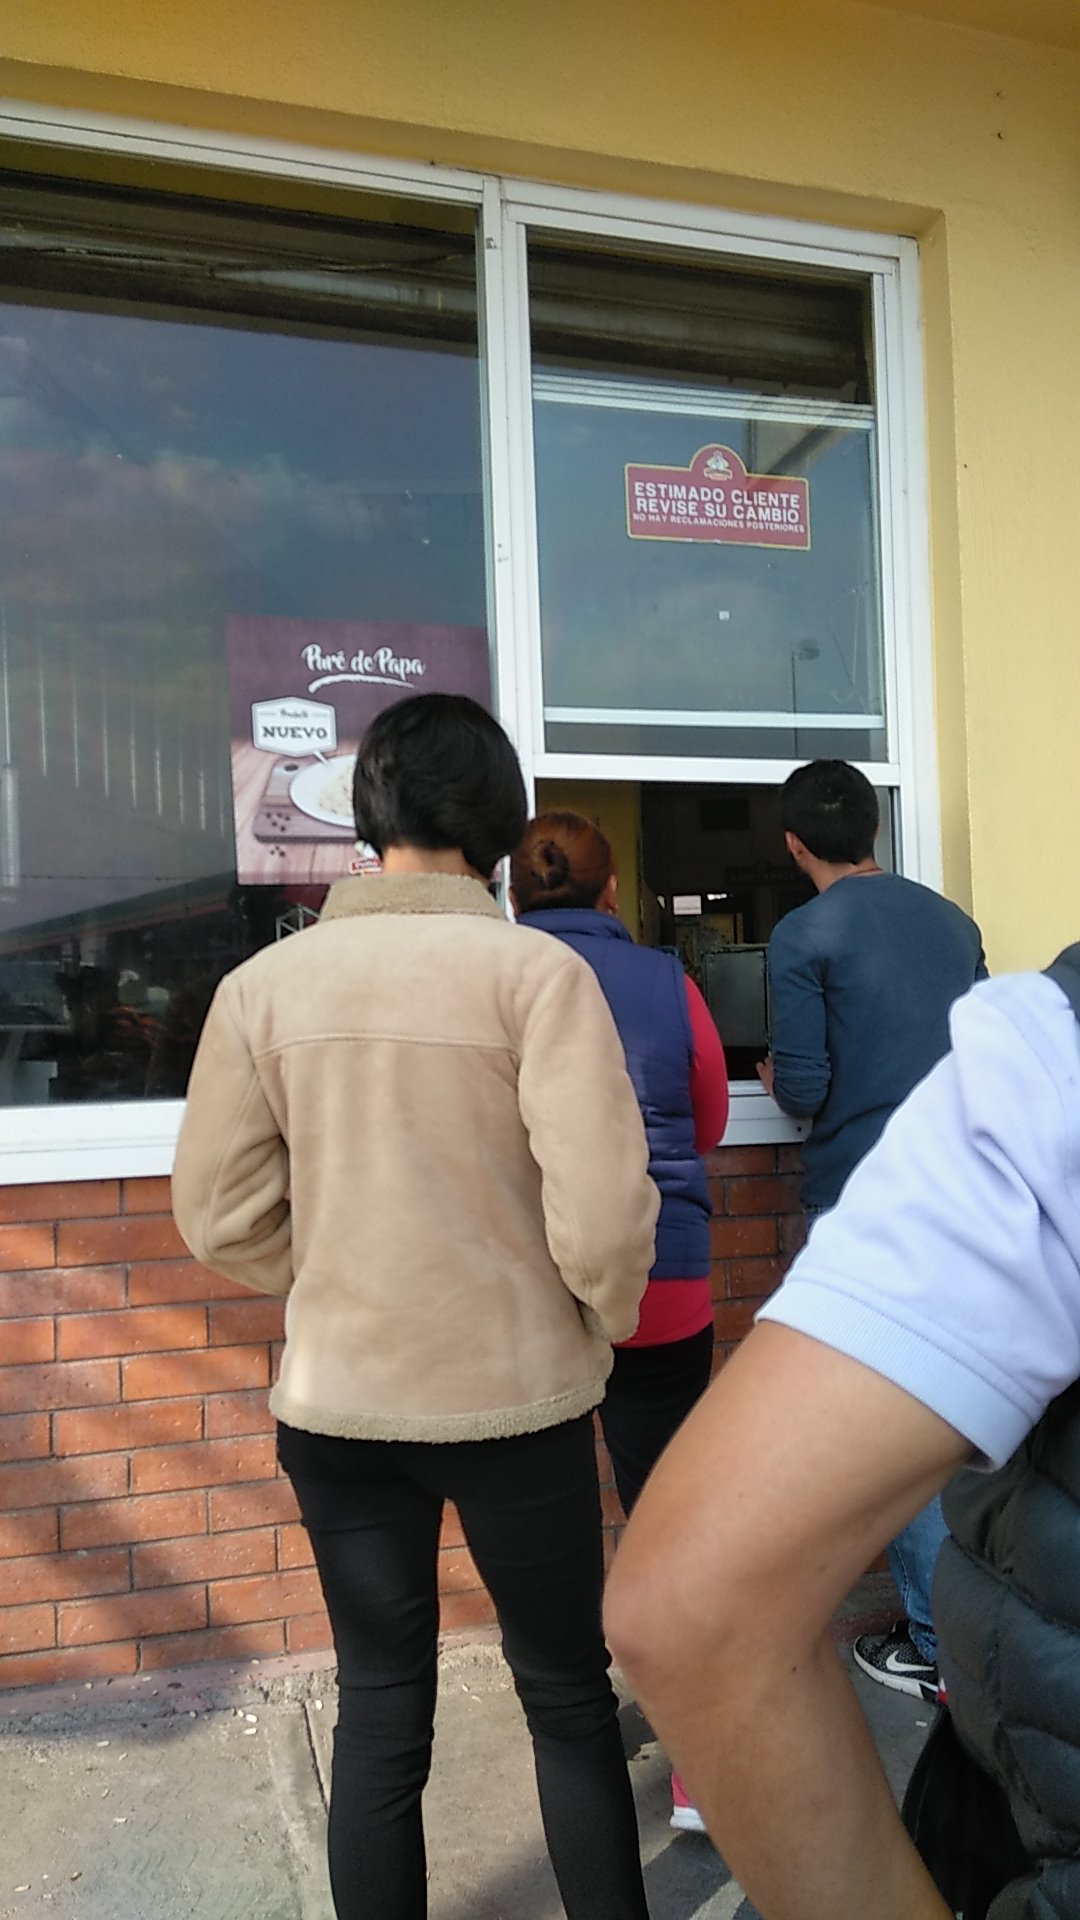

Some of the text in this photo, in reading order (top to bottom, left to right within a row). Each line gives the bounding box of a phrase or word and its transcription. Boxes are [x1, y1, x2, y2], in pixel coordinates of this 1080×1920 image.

[634, 482, 800, 509] ESTIMADO CLIENTE
[633, 513, 805, 533] NO HAY RECLAMACIONES POSTERIORES
[636, 498, 799, 524] REVISE SU CAMBIO
[301, 643, 426, 681] Puré de Papa
[262, 725, 328, 740] NUEVO
